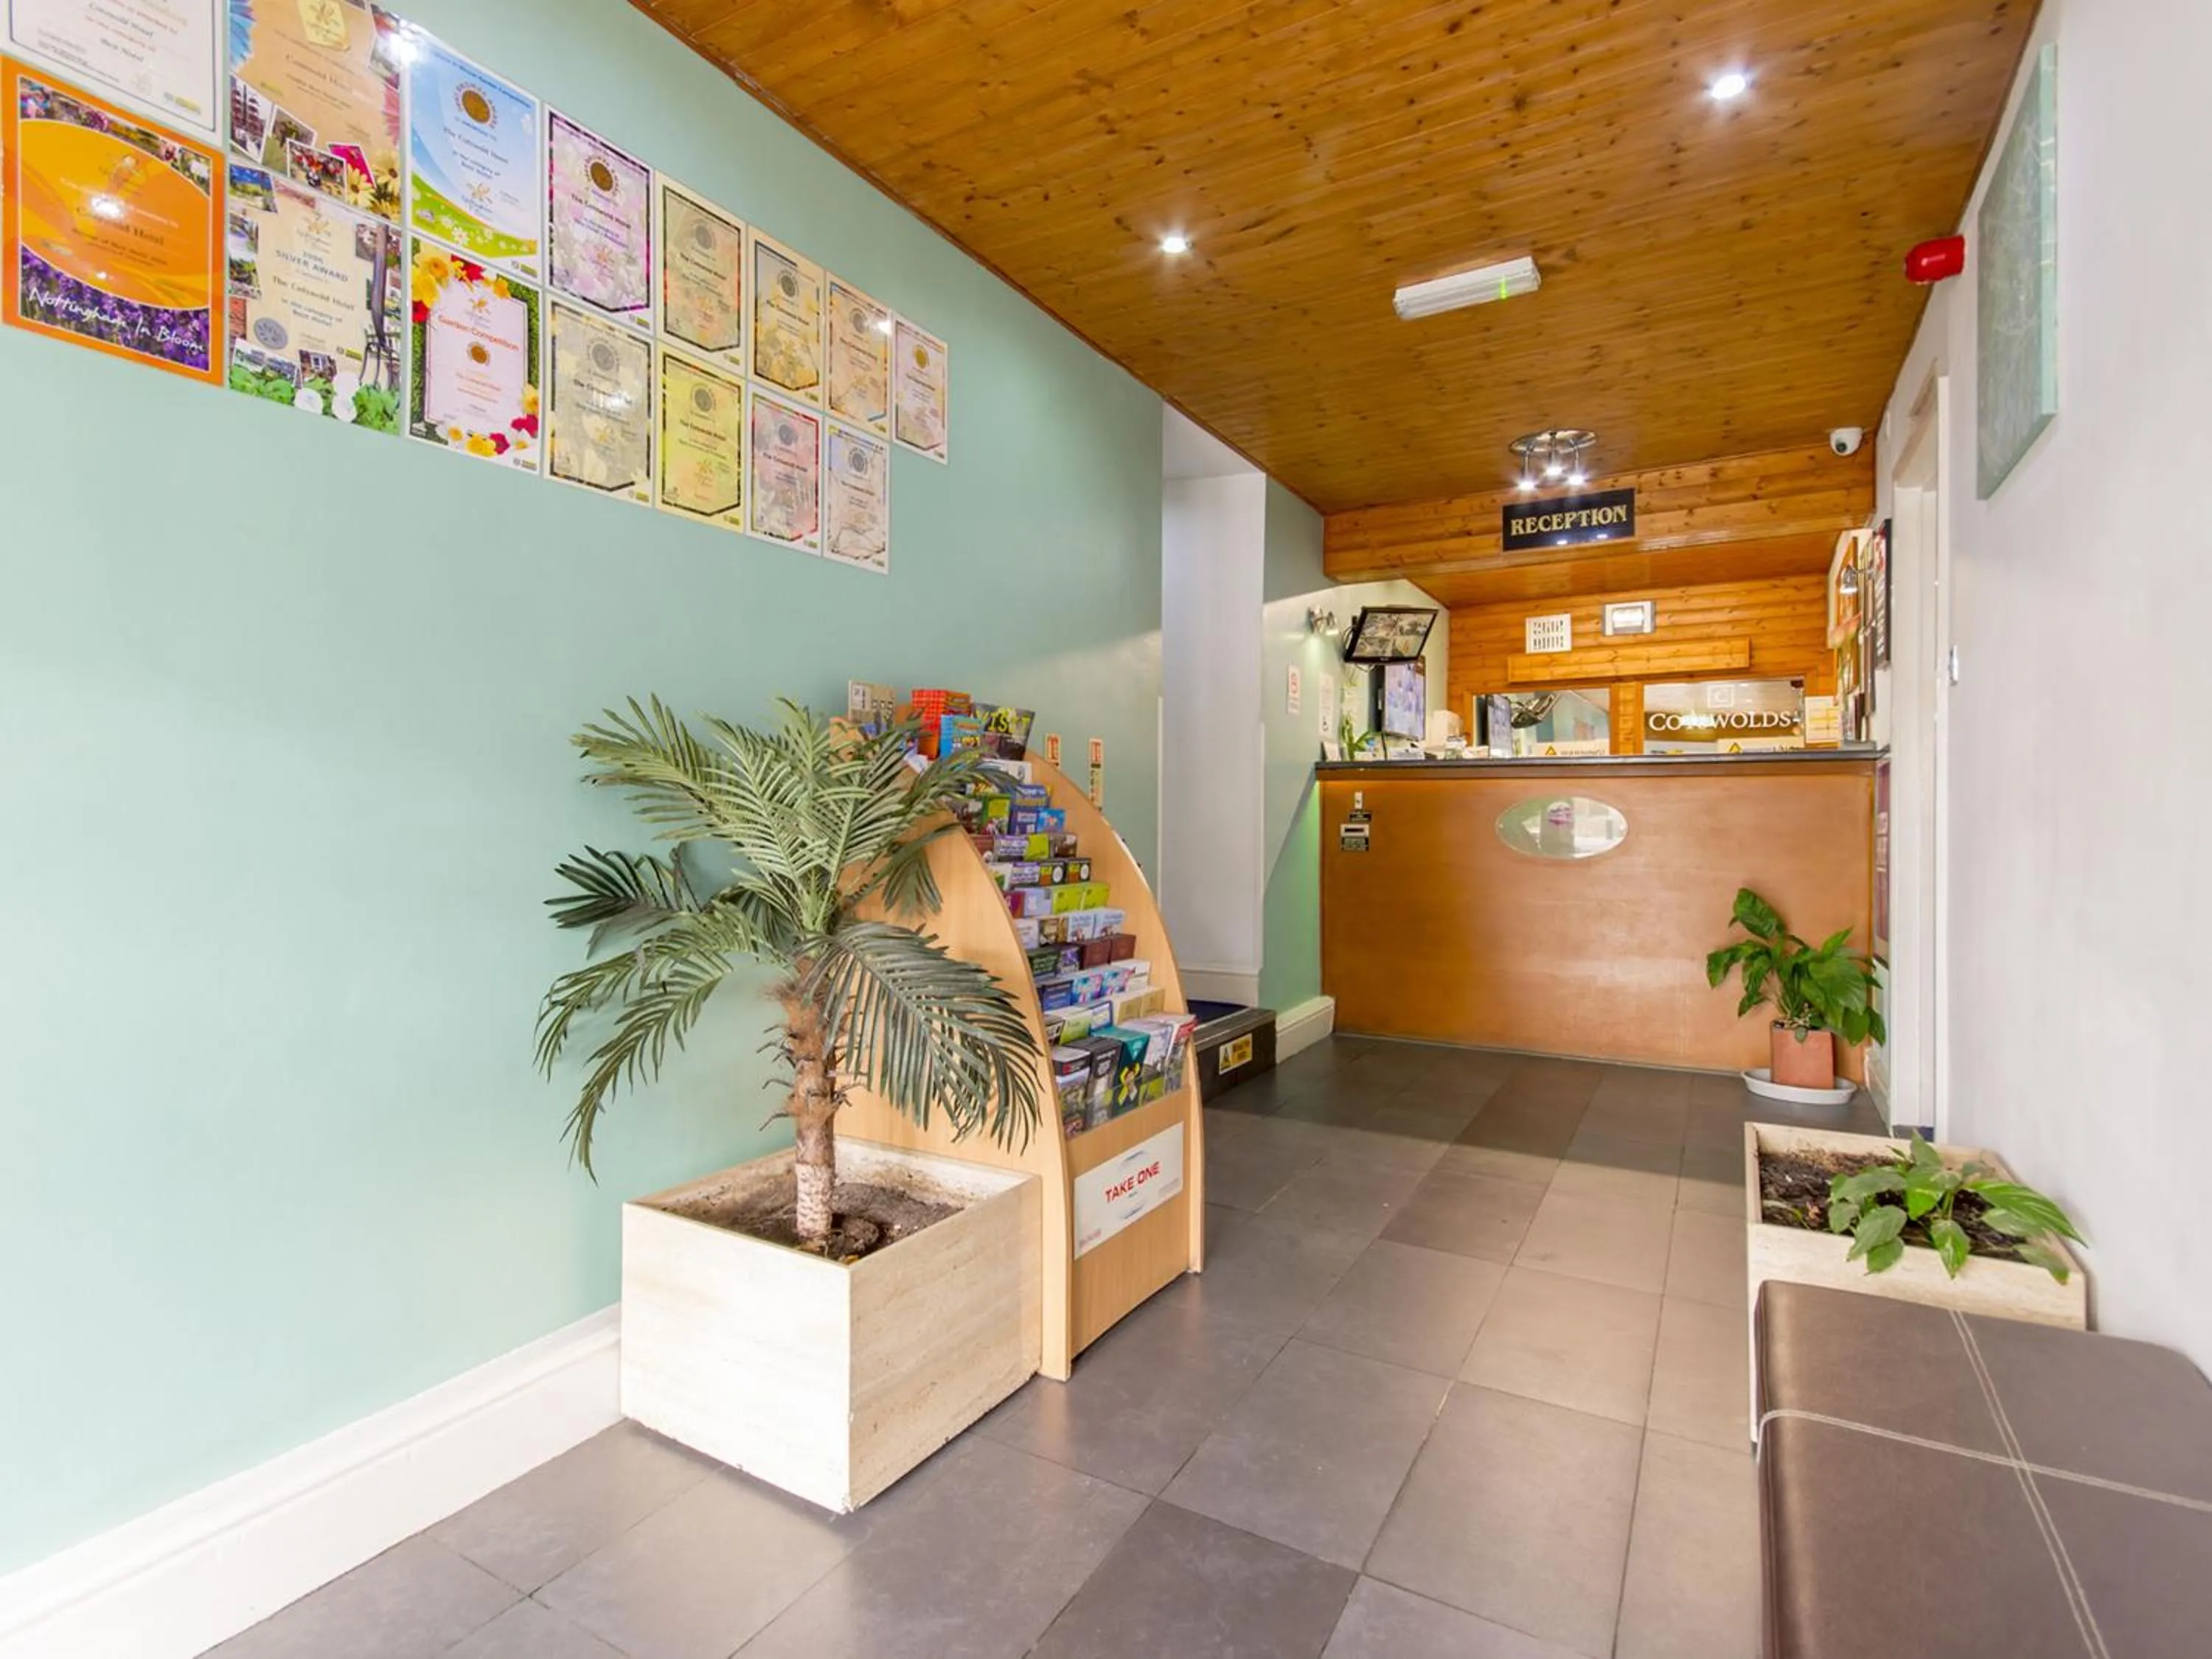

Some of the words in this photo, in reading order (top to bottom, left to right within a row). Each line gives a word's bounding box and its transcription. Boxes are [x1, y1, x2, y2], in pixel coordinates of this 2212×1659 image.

[274, 249, 309, 268] SILVER
[311, 263, 349, 282] AWARD
[29, 287, 128, 327] Nottingham
[156, 325, 204, 352] Bloom
[1510, 504, 1628, 537] RECEPTION
[1648, 710, 1791, 731] COWOLDS
[1105, 1175, 1135, 1204] TAKE
[1136, 1161, 1161, 1185] ONE
